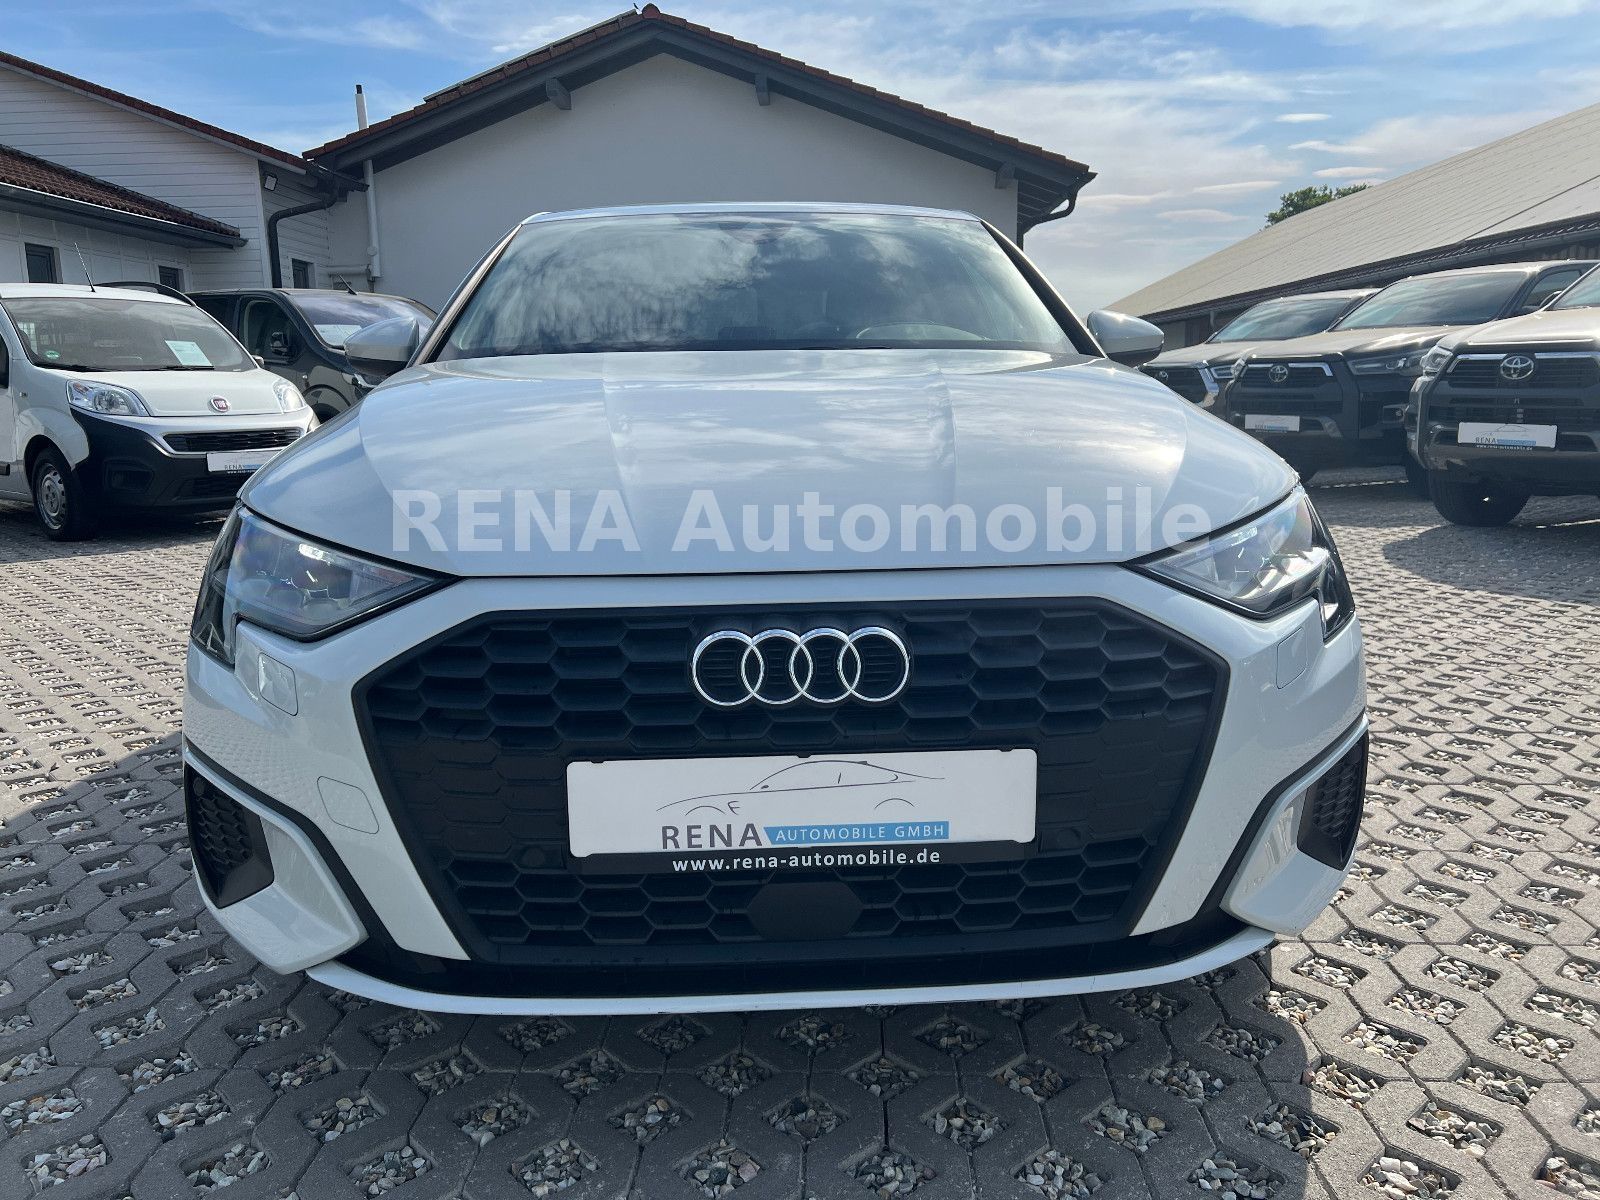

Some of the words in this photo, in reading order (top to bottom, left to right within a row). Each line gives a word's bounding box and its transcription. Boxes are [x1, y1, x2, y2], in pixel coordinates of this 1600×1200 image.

[662, 823, 763, 849] RENA
[775, 826, 886, 842] AUTOMOBILE
[894, 825, 944, 838] GMBH
[672, 849, 941, 871] www.rena-automobile.de
